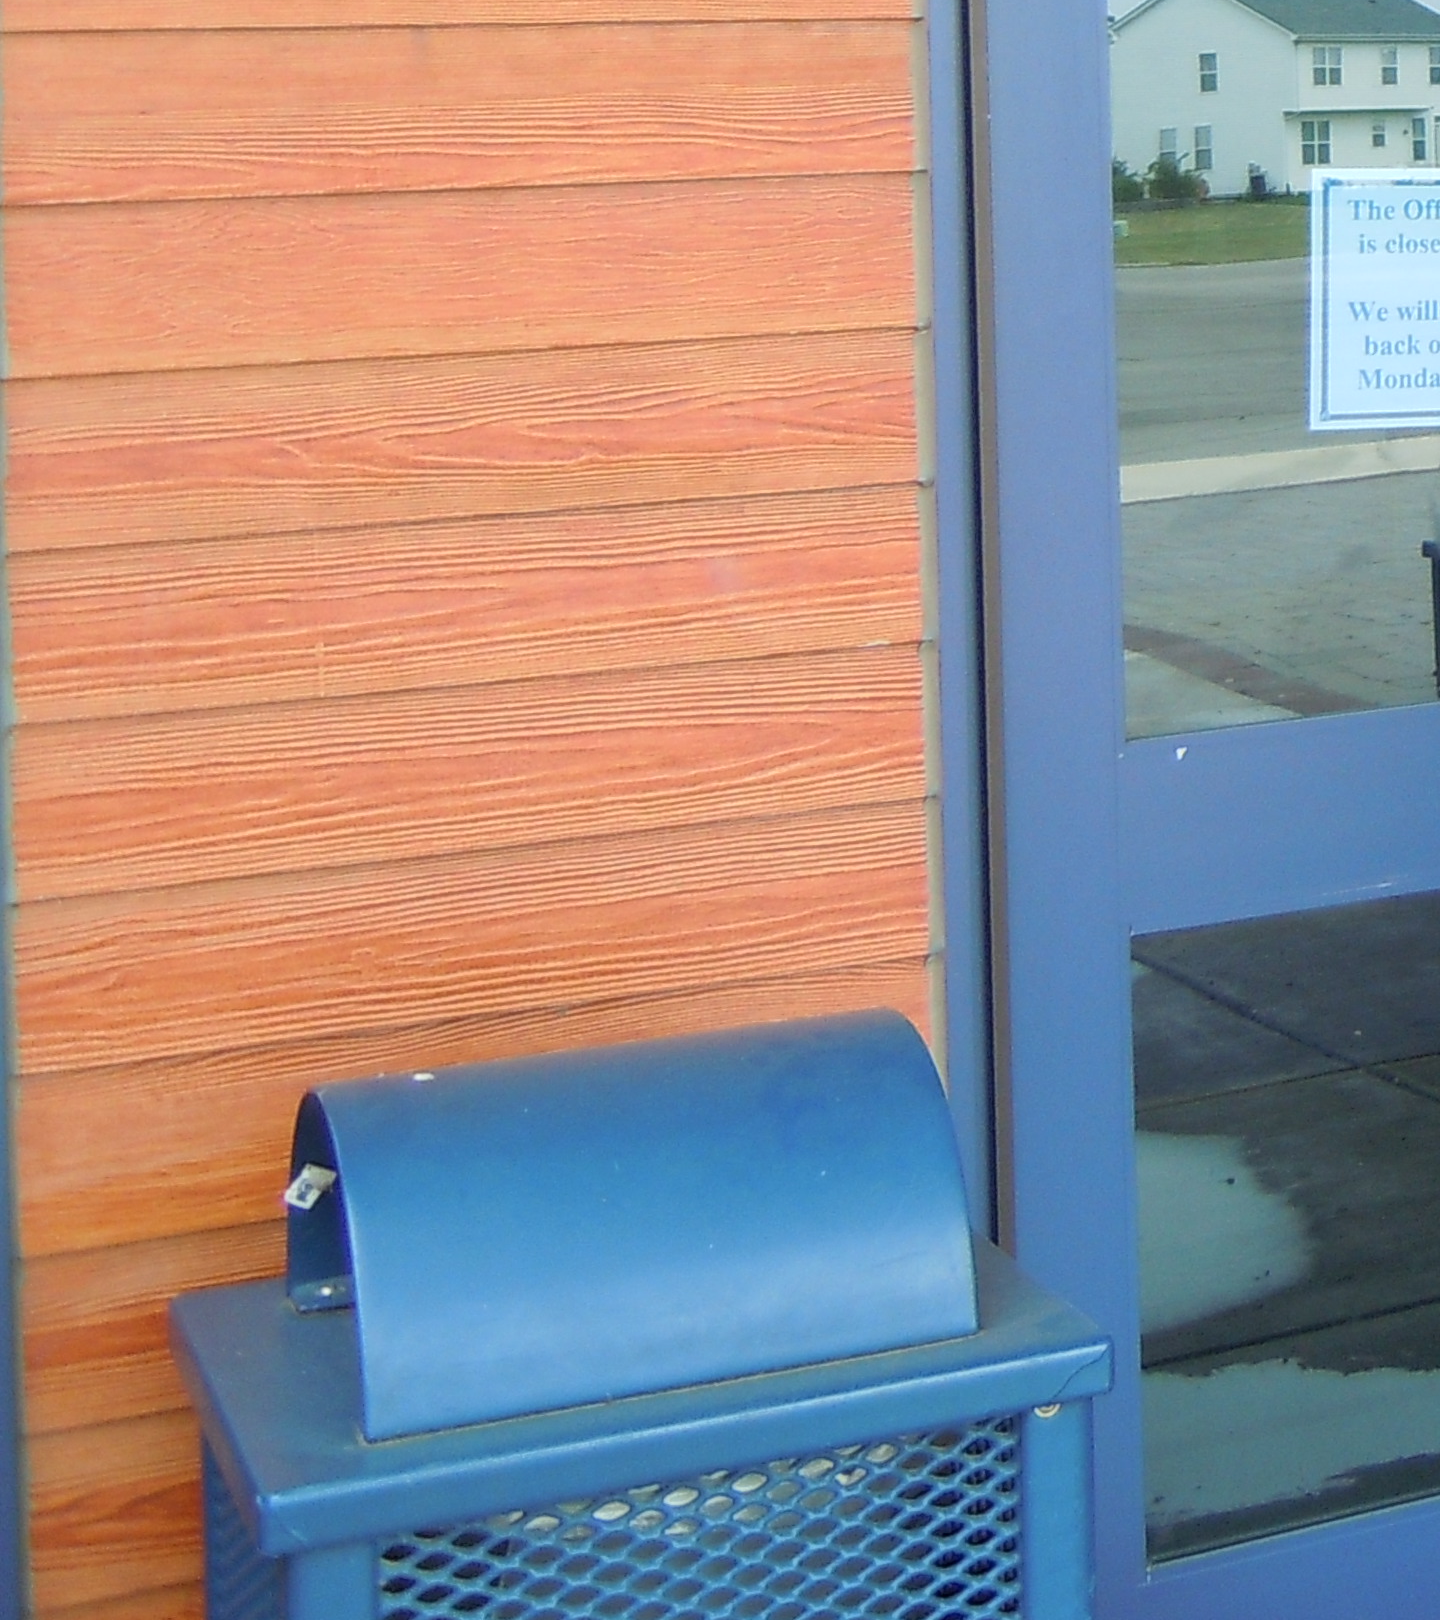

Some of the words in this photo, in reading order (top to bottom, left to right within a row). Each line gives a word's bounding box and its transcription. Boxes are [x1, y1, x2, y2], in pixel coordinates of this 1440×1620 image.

[1348, 198, 1395, 221] The
[1358, 234, 1377, 254] is
[1349, 301, 1388, 322] We
[1397, 300, 1438, 321] will
[1364, 334, 1421, 356] back
